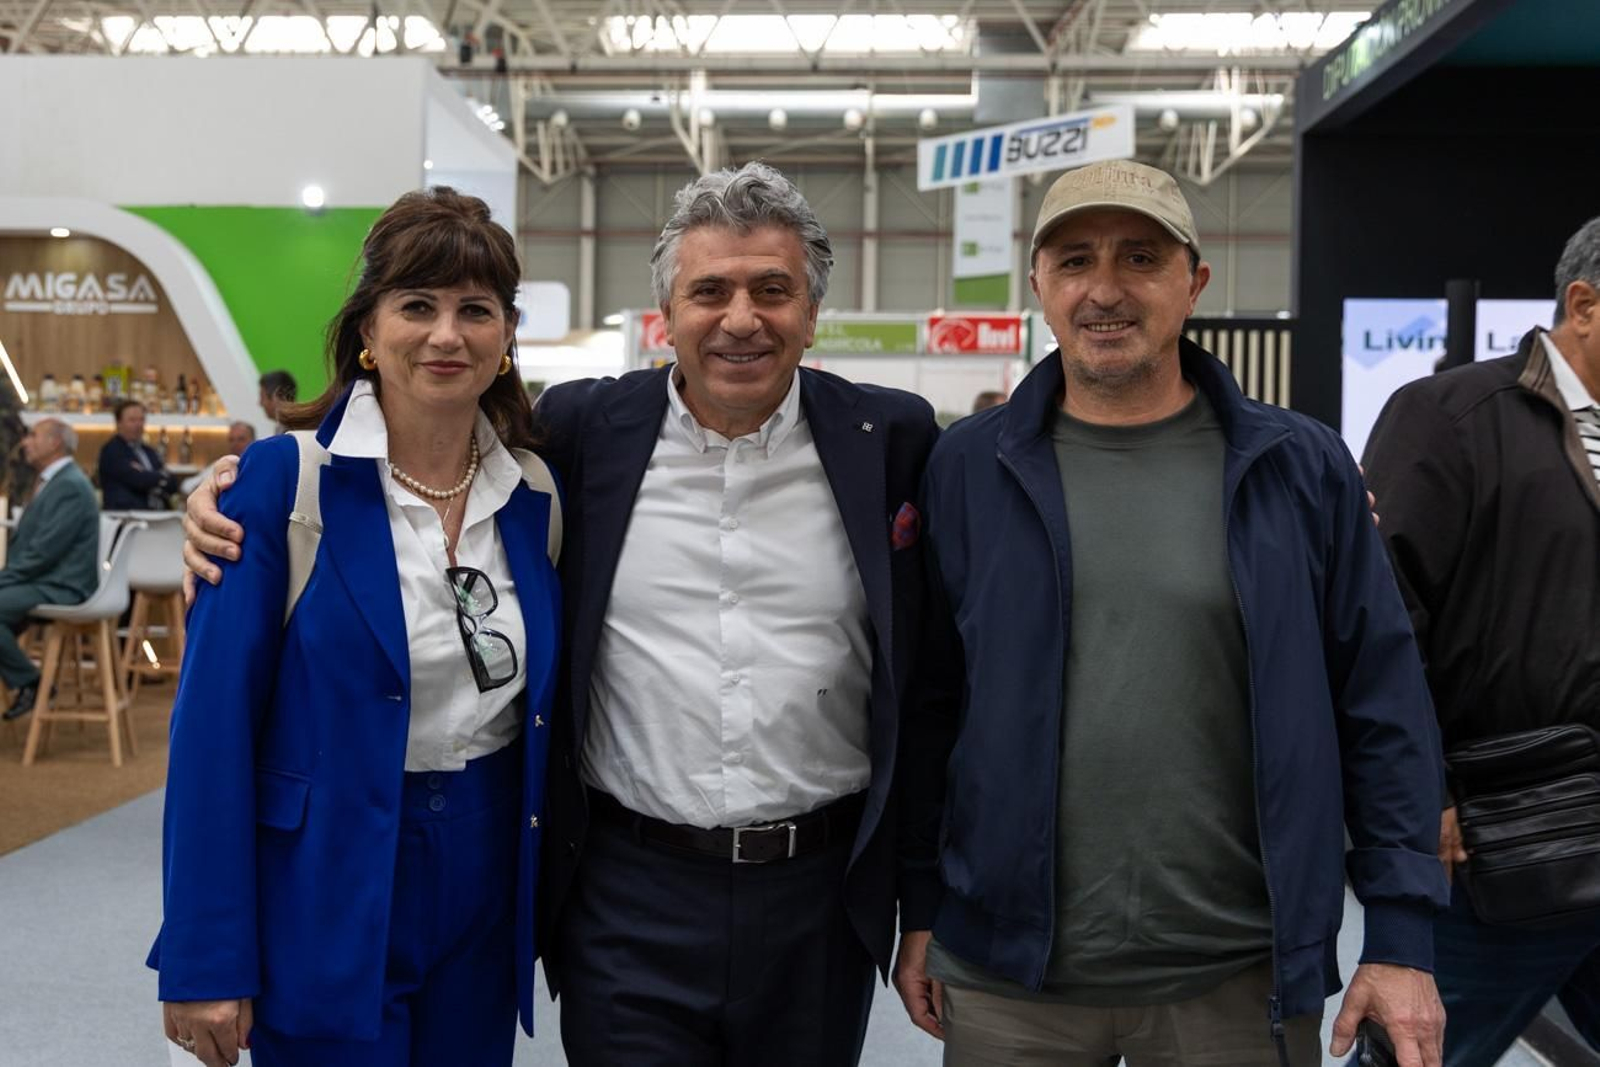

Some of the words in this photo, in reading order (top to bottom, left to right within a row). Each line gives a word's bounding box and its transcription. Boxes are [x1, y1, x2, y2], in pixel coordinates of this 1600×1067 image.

[1006, 126, 1088, 162] BUZZI
[4, 271, 158, 300] MIGASA
[1364, 329, 1448, 351] Livin
